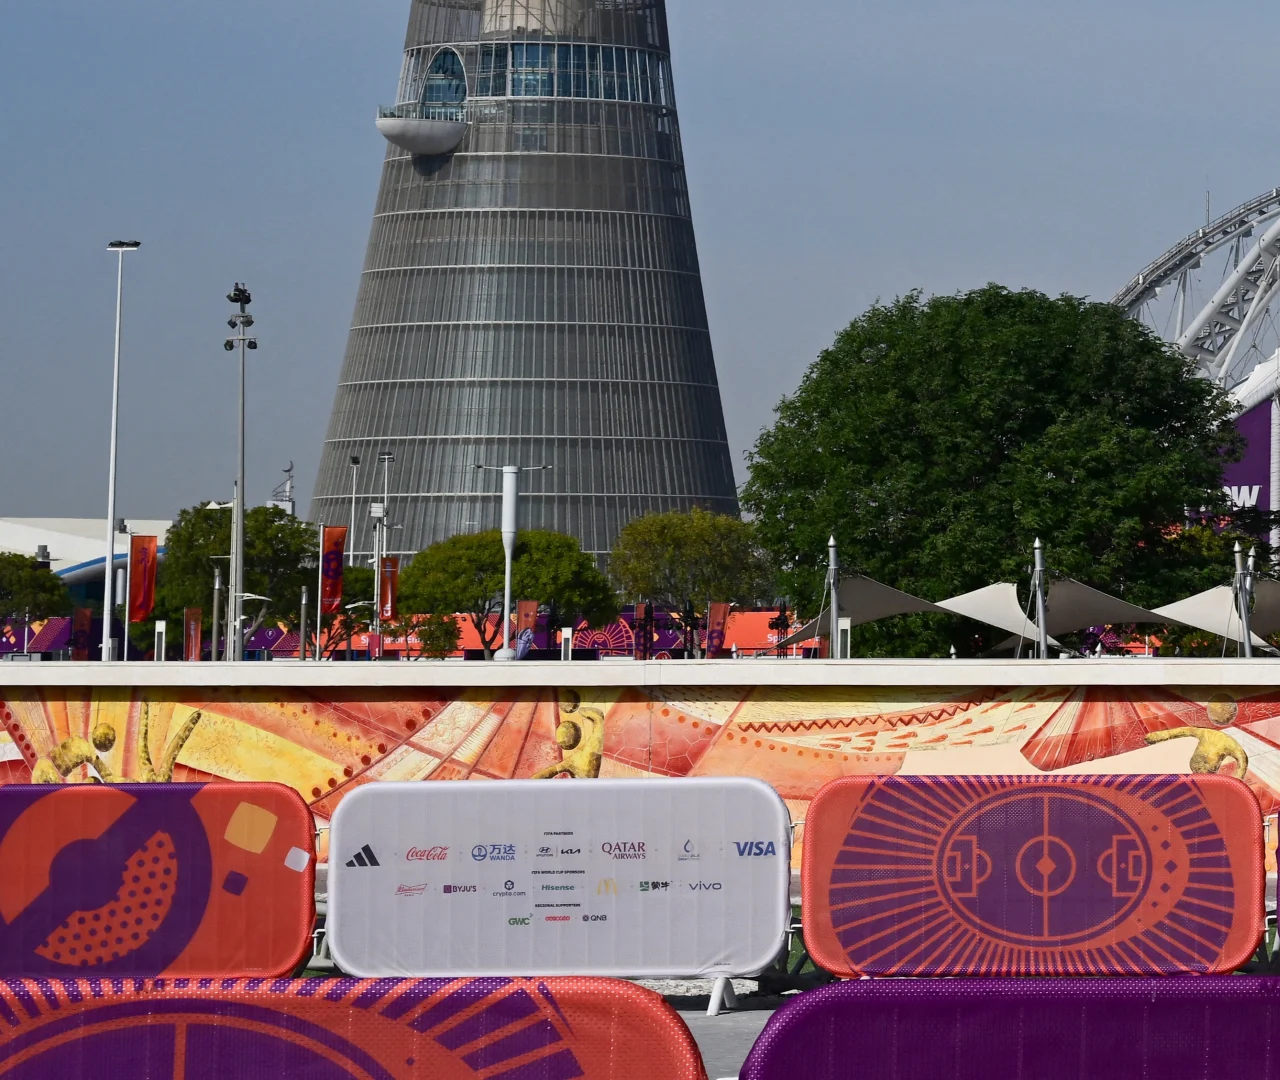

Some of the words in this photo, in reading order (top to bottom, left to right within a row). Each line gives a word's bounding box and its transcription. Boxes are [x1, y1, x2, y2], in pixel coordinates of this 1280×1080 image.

[489, 844, 516, 855] 万达
[602, 841, 646, 854] QATAR
[733, 841, 776, 857] VISA
[406, 846, 450, 861] Coca-Cola
[452, 885, 477, 893] BYJU'S
[689, 881, 722, 890] vivo
[508, 917, 530, 926] GWC
